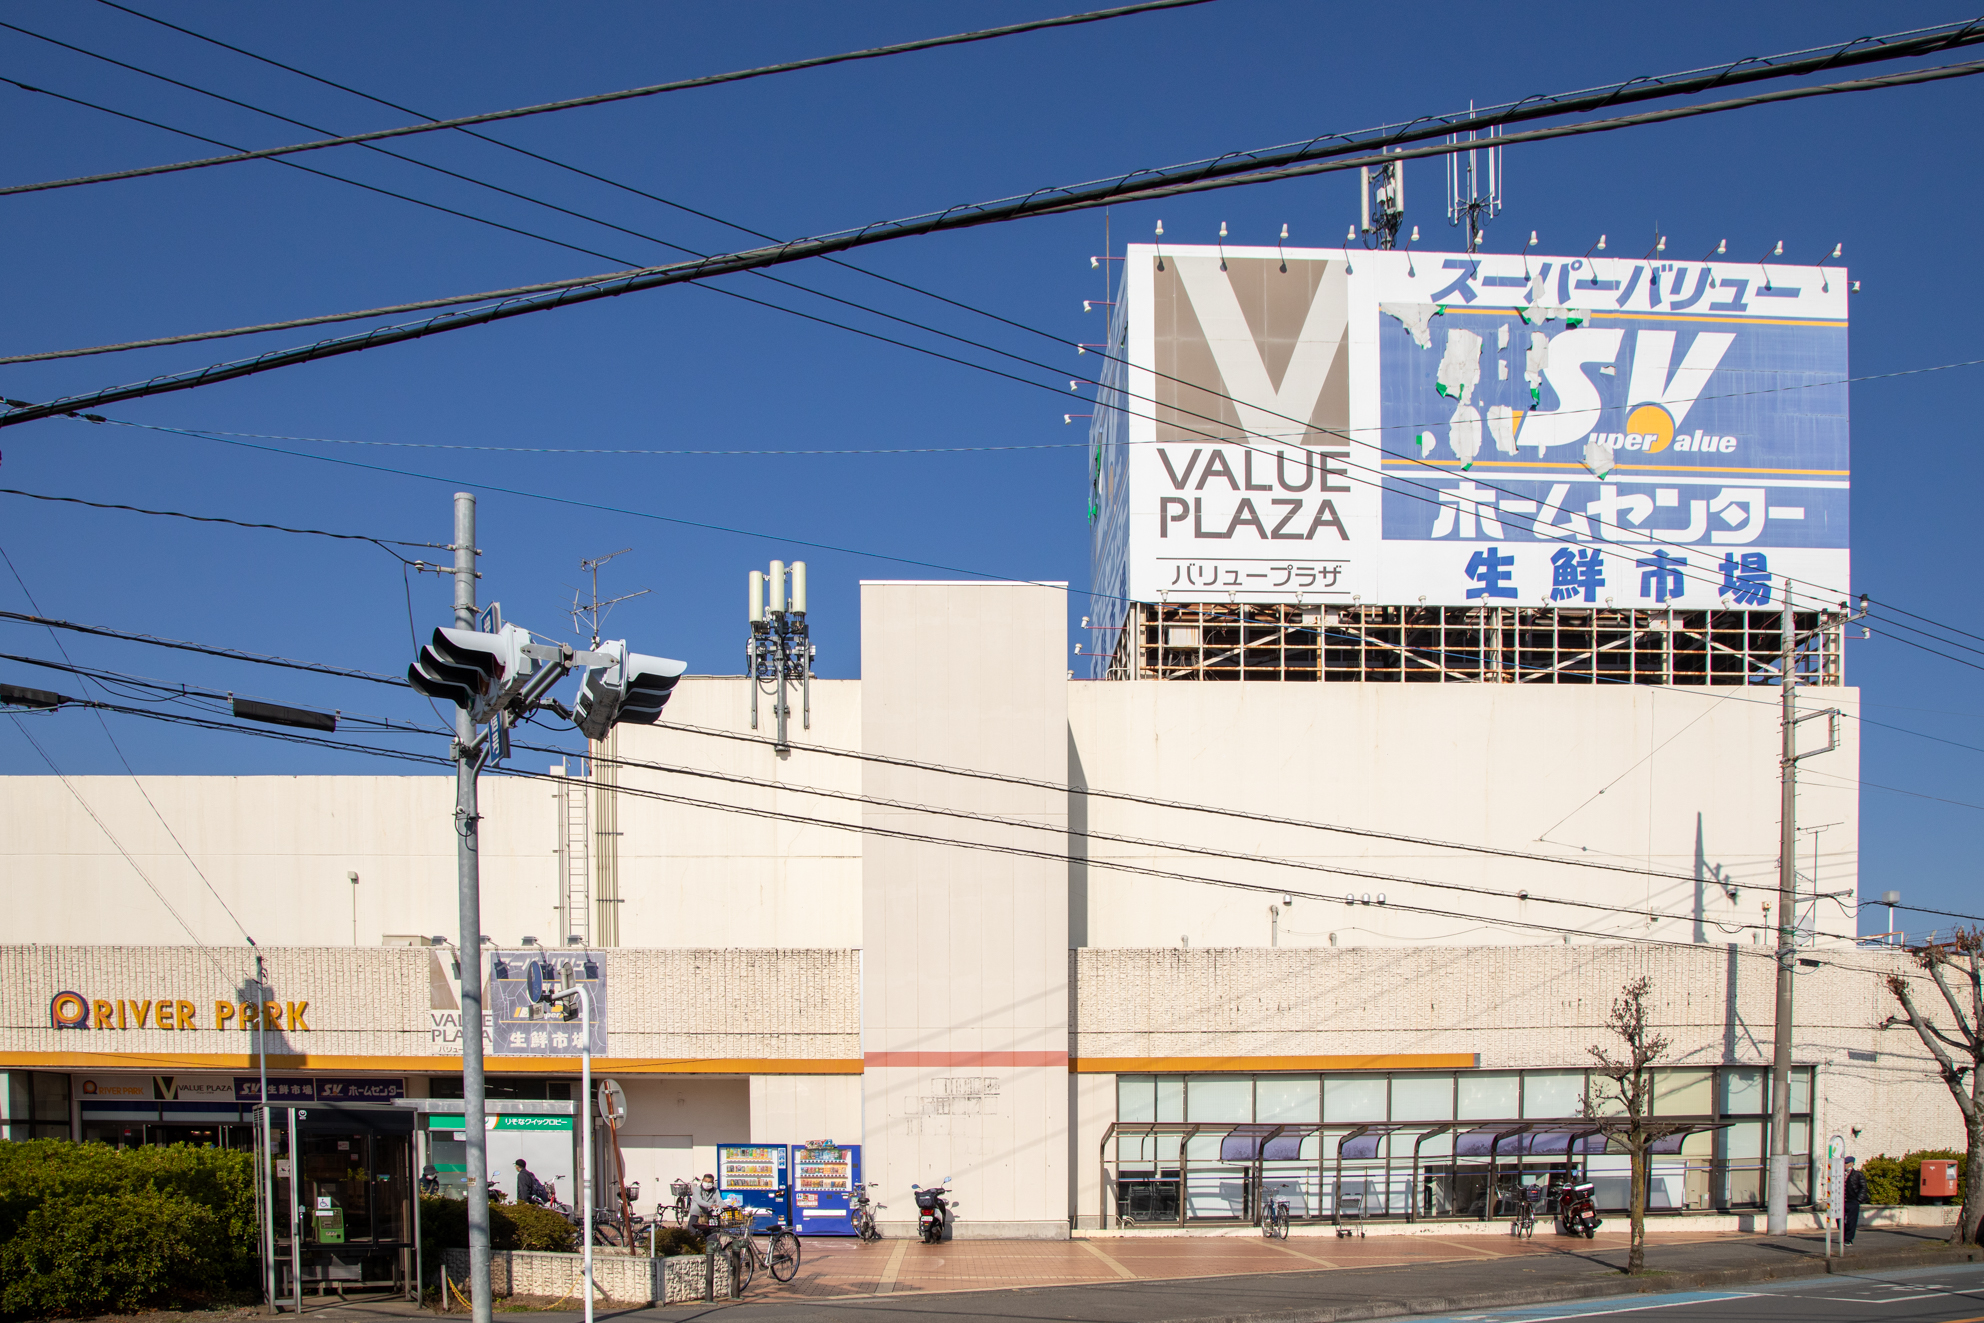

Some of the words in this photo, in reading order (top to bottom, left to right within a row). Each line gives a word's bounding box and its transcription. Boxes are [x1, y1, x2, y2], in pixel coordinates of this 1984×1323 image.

[1429, 258, 1802, 312] スーパーバリュー
[1673, 429, 1738, 453] alue
[1156, 448, 1351, 492] VALUE
[1160, 496, 1350, 541] PLAZA
[1431, 483, 1805, 544] ホームセンター
[1172, 563, 1342, 587] バリュープラザ
[1464, 546, 1772, 606] 生鮮市場
[93, 999, 197, 1029] RIVER
[215, 1000, 310, 1031] PARK
[431, 1013, 493, 1027] VALE
[431, 1029, 493, 1043] PLAA
[98, 1086, 122, 1095] RIVER
[122, 1086, 145, 1095] PARK
[178, 1084, 205, 1092] VALUE
[267, 1084, 313, 1095] 生鮮市場
[348, 1085, 404, 1096] ホームセンター
[504, 1117, 568, 1126] りそなクイックロビー
